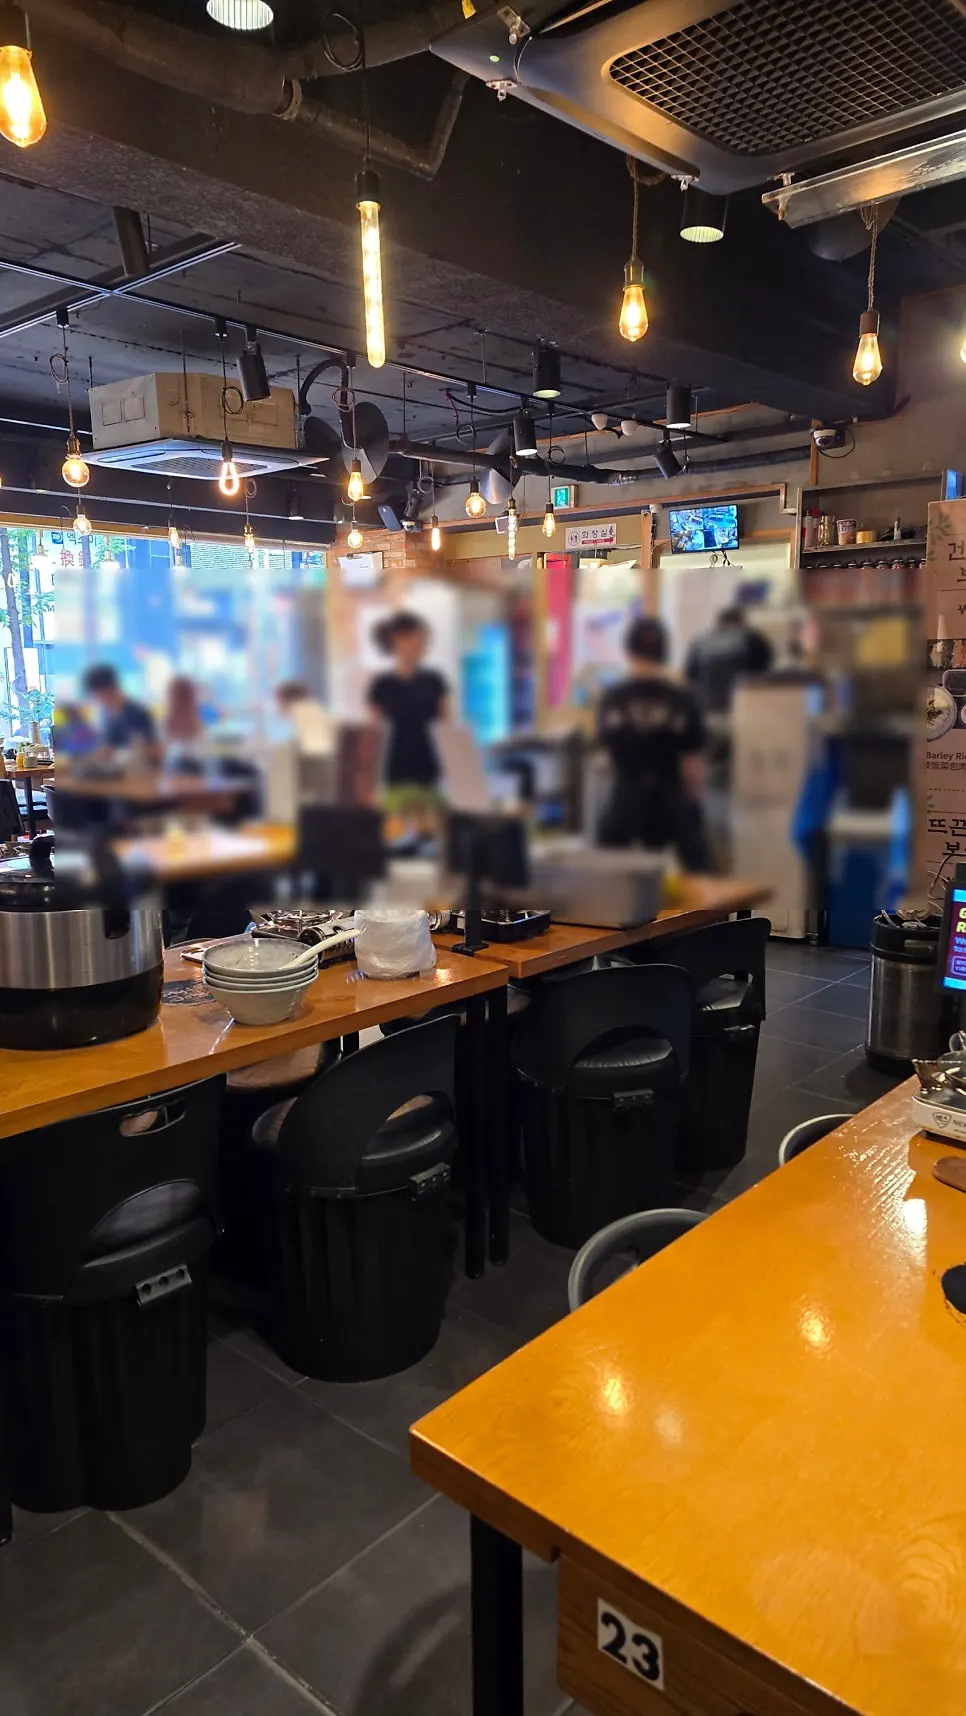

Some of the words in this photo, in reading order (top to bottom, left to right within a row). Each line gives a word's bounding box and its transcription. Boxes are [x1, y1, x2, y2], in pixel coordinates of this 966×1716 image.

[581, 529, 607, 538] 화장실
[927, 751, 954, 761] Barley
[956, 752, 966, 760] Ri
[601, 1611, 660, 1682] 23
